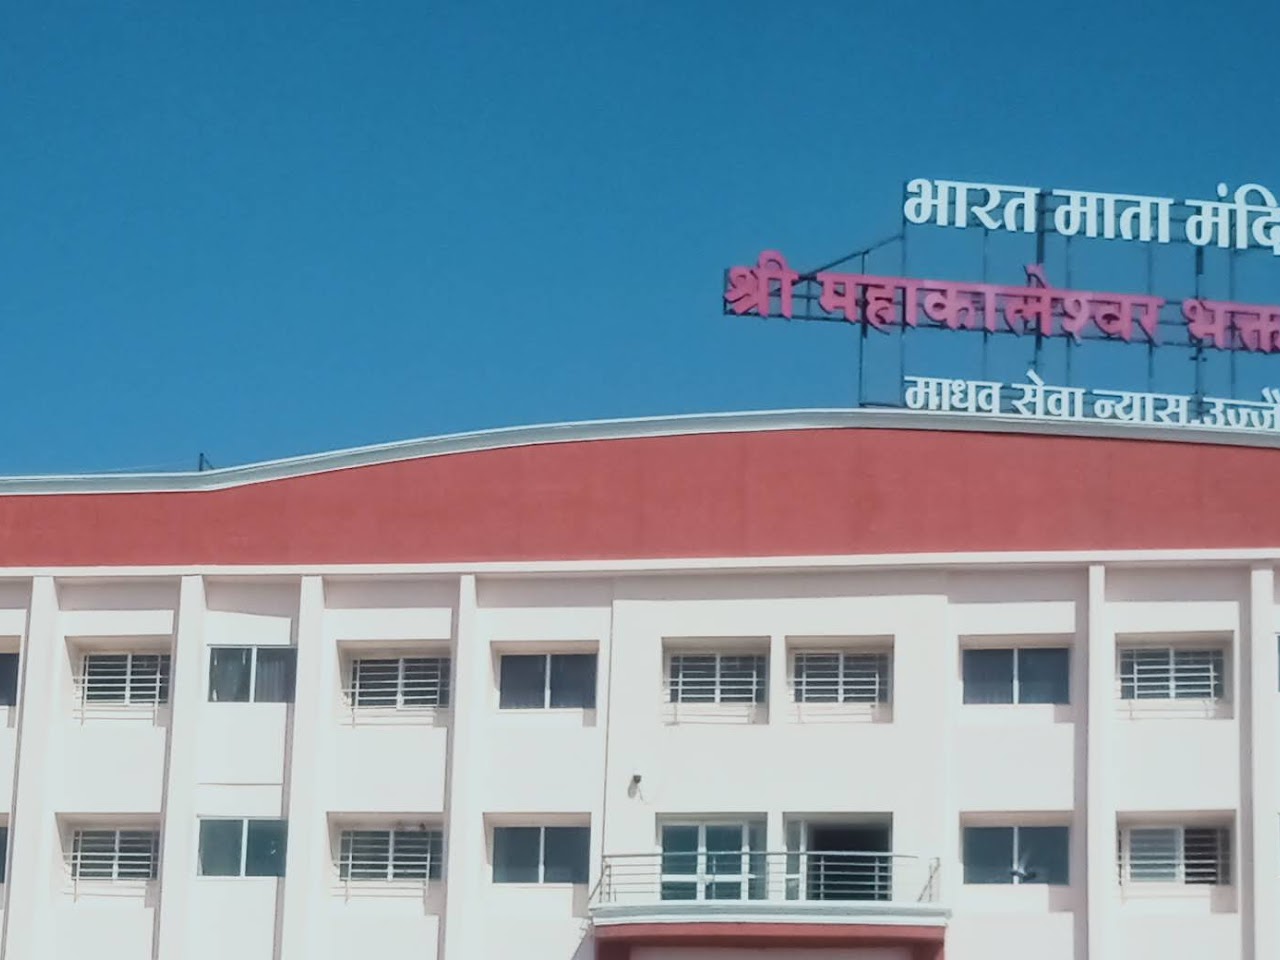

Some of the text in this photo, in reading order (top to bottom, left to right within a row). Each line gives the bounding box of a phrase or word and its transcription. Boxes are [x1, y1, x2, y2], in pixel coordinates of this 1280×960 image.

[904, 178, 1041, 233] भारत
[1052, 189, 1174, 243] माता
[725, 250, 798, 320] श्री
[904, 376, 1003, 412] माधव
[1011, 369, 1085, 418] सेवा
